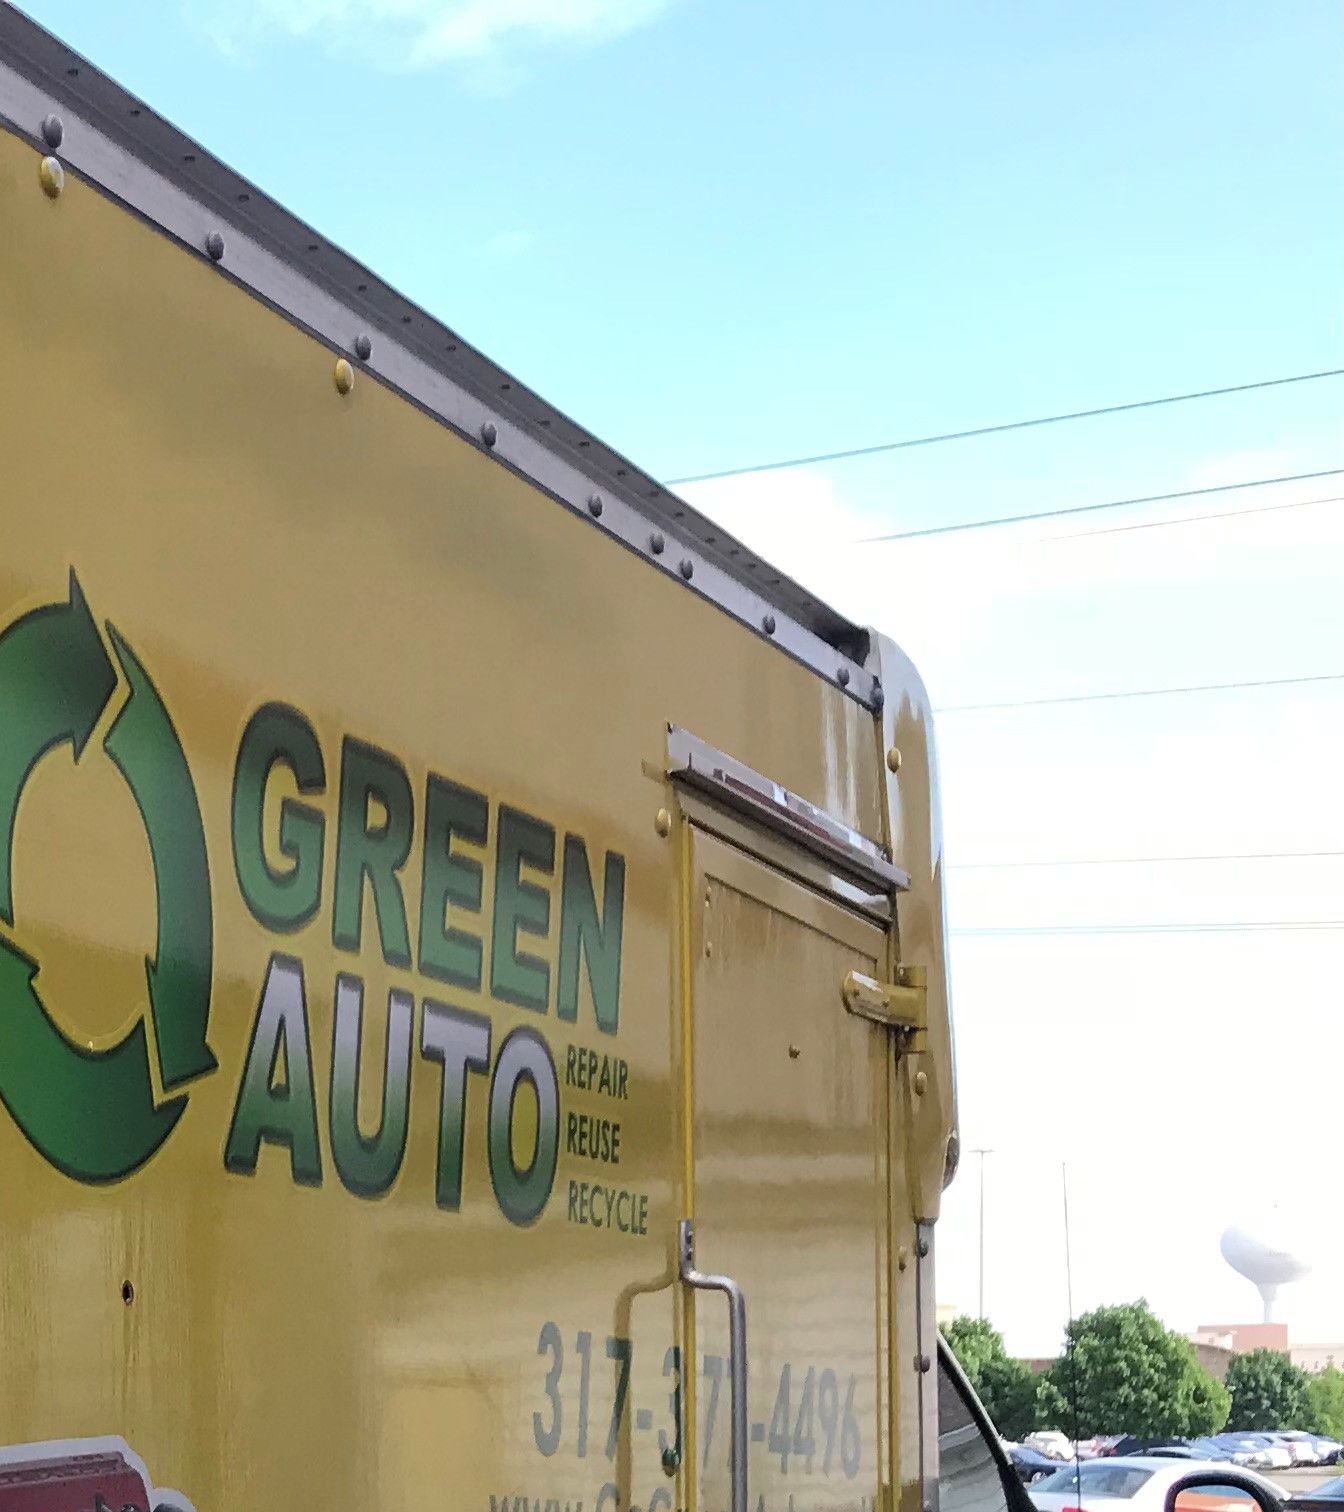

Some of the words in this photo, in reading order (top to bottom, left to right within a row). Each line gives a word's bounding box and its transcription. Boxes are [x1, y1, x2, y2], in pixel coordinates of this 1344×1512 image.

[229, 701, 625, 1034] GREEN
[223, 954, 560, 1227] AUTO
[566, 1044, 628, 1099] REPAIR
[567, 1112, 620, 1163] REUSE
[568, 1180, 648, 1235] RECYCLE
[533, 1321, 861, 1480] 317-37-4496
